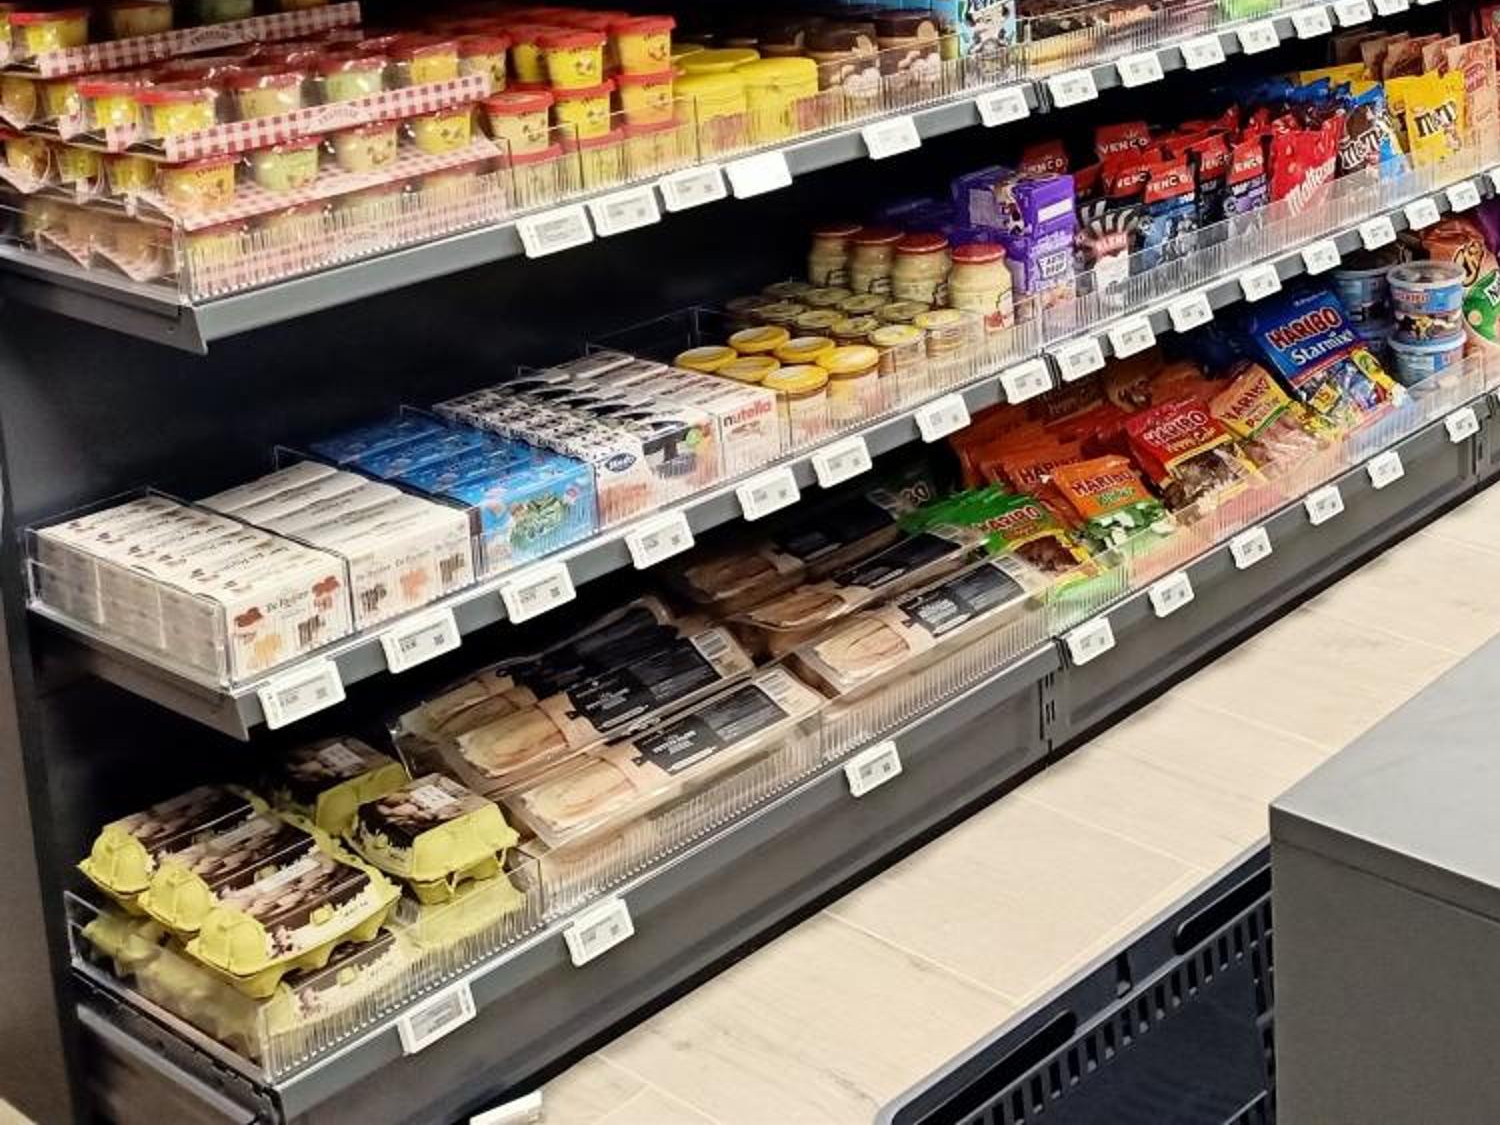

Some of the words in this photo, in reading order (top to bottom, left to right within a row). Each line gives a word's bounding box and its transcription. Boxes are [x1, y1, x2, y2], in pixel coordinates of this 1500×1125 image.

[1101, 138, 1148, 155] VENCO
[1266, 306, 1343, 351] HARIBO
[1291, 330, 1355, 365] Starmix
[723, 400, 772, 427] nutella
[1143, 410, 1209, 446] HARIBO
